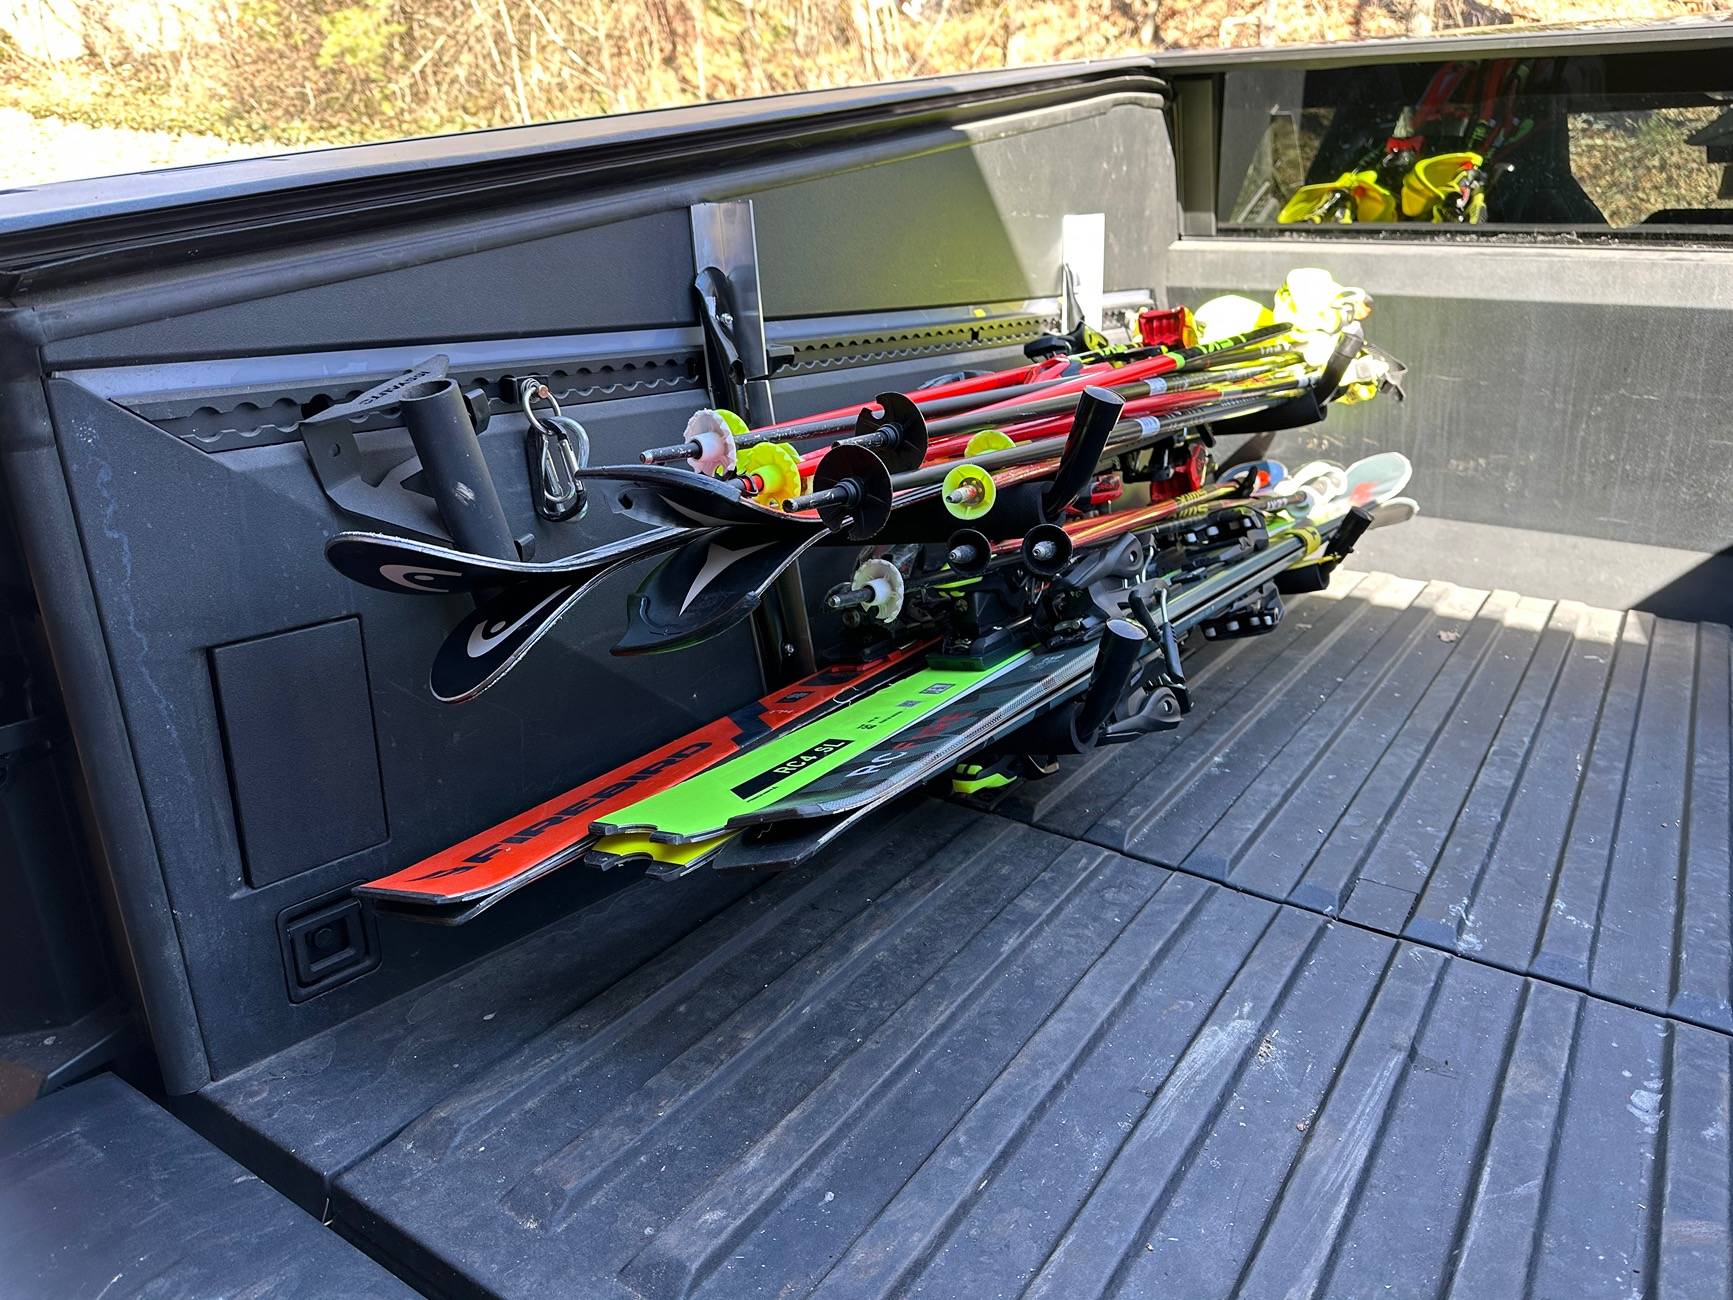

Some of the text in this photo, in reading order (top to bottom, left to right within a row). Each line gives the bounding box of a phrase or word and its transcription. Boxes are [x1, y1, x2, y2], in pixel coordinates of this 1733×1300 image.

[774, 740, 846, 775] RC4 SL
[845, 752, 908, 777] RC
[465, 741, 713, 864] FIREBIRD
